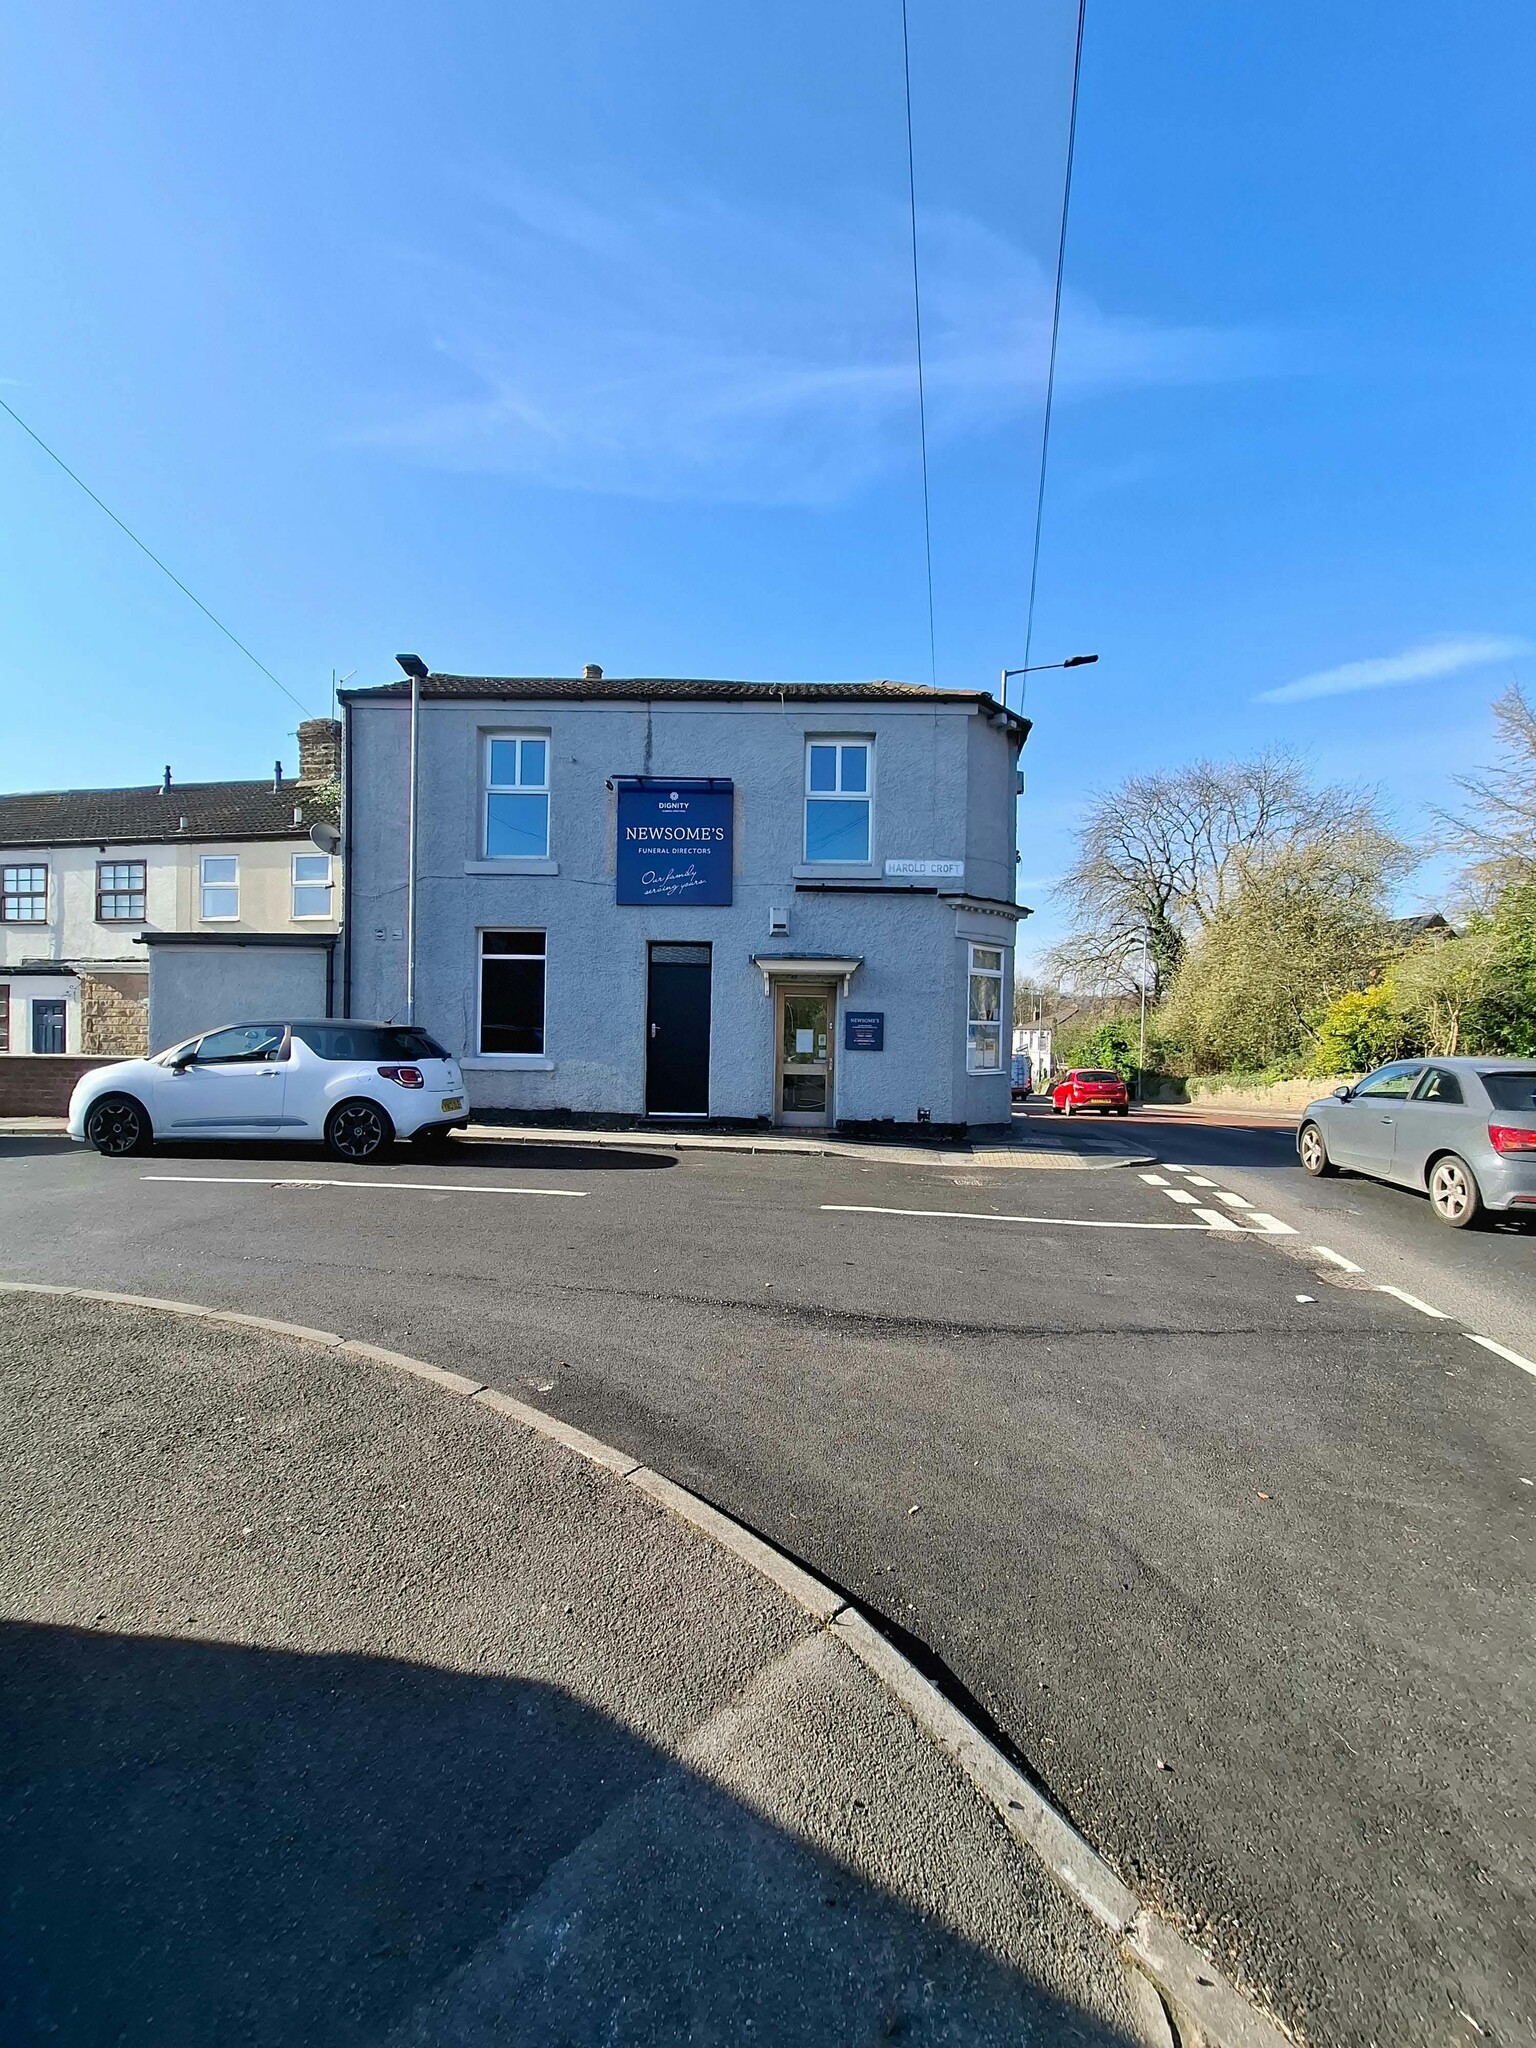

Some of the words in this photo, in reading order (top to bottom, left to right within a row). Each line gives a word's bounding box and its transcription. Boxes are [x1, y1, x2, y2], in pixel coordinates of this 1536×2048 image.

[626, 827, 724, 840] NEWSOME'S
[672, 847, 711, 855] DIRECTORS
[888, 862, 926, 873] HAROLD
[930, 863, 961, 874] CROFT
[641, 870, 665, 885] Our
[660, 863, 697, 888] family
[643, 882, 680, 896] serving
